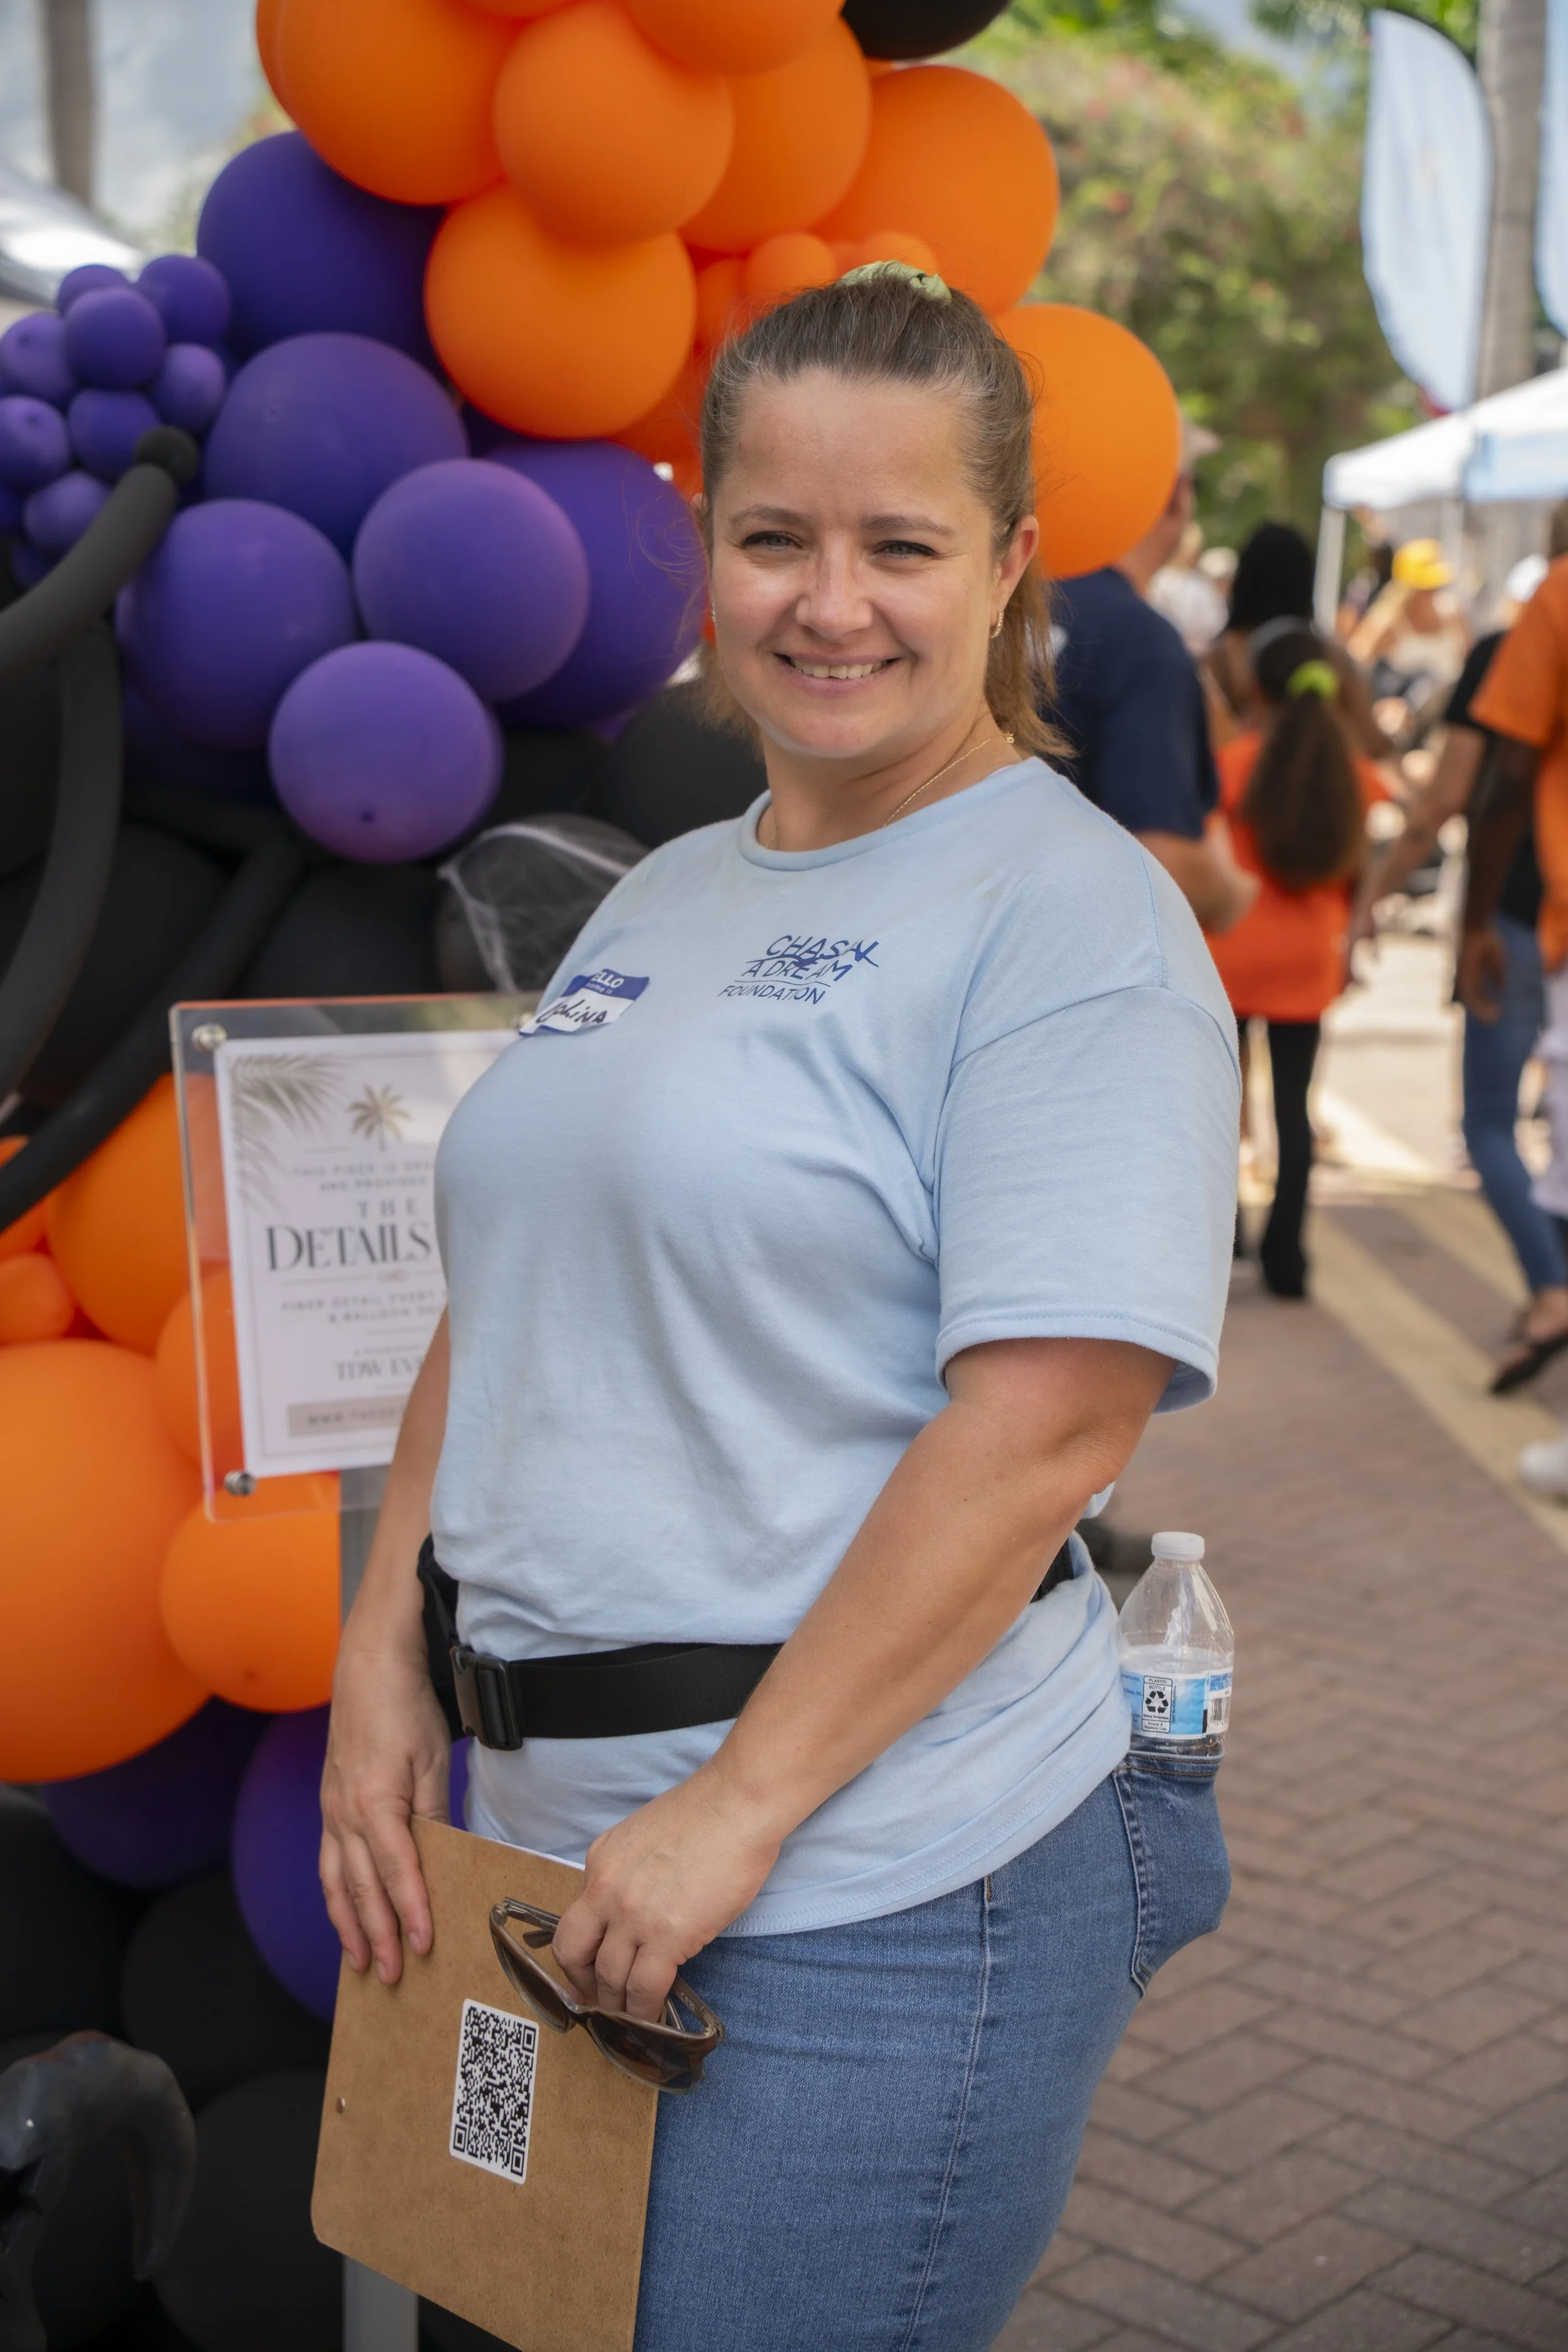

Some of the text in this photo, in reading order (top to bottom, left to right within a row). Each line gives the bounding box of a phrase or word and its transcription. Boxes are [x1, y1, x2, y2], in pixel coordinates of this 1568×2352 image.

[590, 972, 624, 988] ELLO
[762, 959, 854, 982] DREAM
[718, 984, 826, 1004] FOUNDATION
[357, 1197, 419, 1219] THE
[266, 1220, 432, 1272] DETAILS
